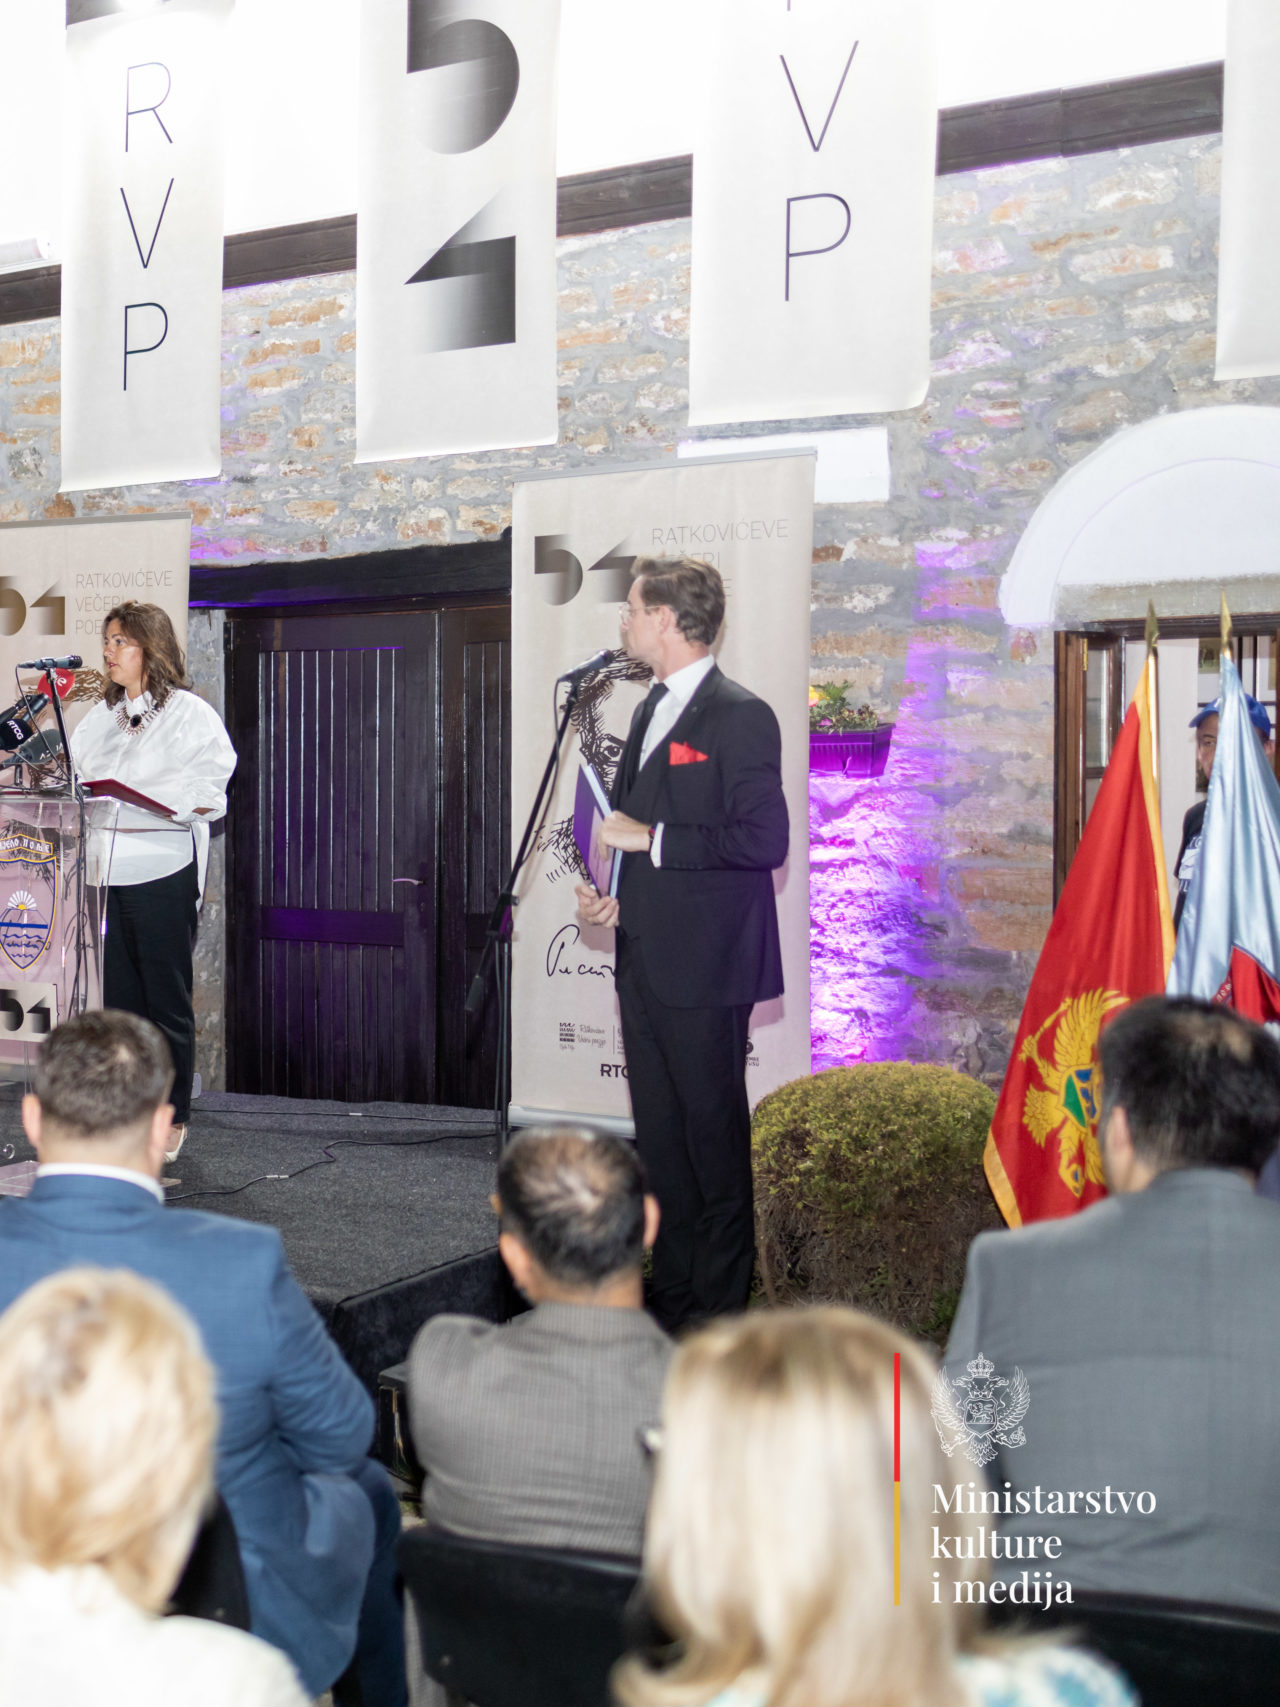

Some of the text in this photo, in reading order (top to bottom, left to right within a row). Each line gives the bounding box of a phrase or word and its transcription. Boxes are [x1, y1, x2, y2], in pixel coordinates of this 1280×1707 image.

[780, 0, 858, 302] VP
[652, 518, 789, 546] RATKOVIĆEVE
[75, 570, 173, 589] RATKOVIĆEVE
